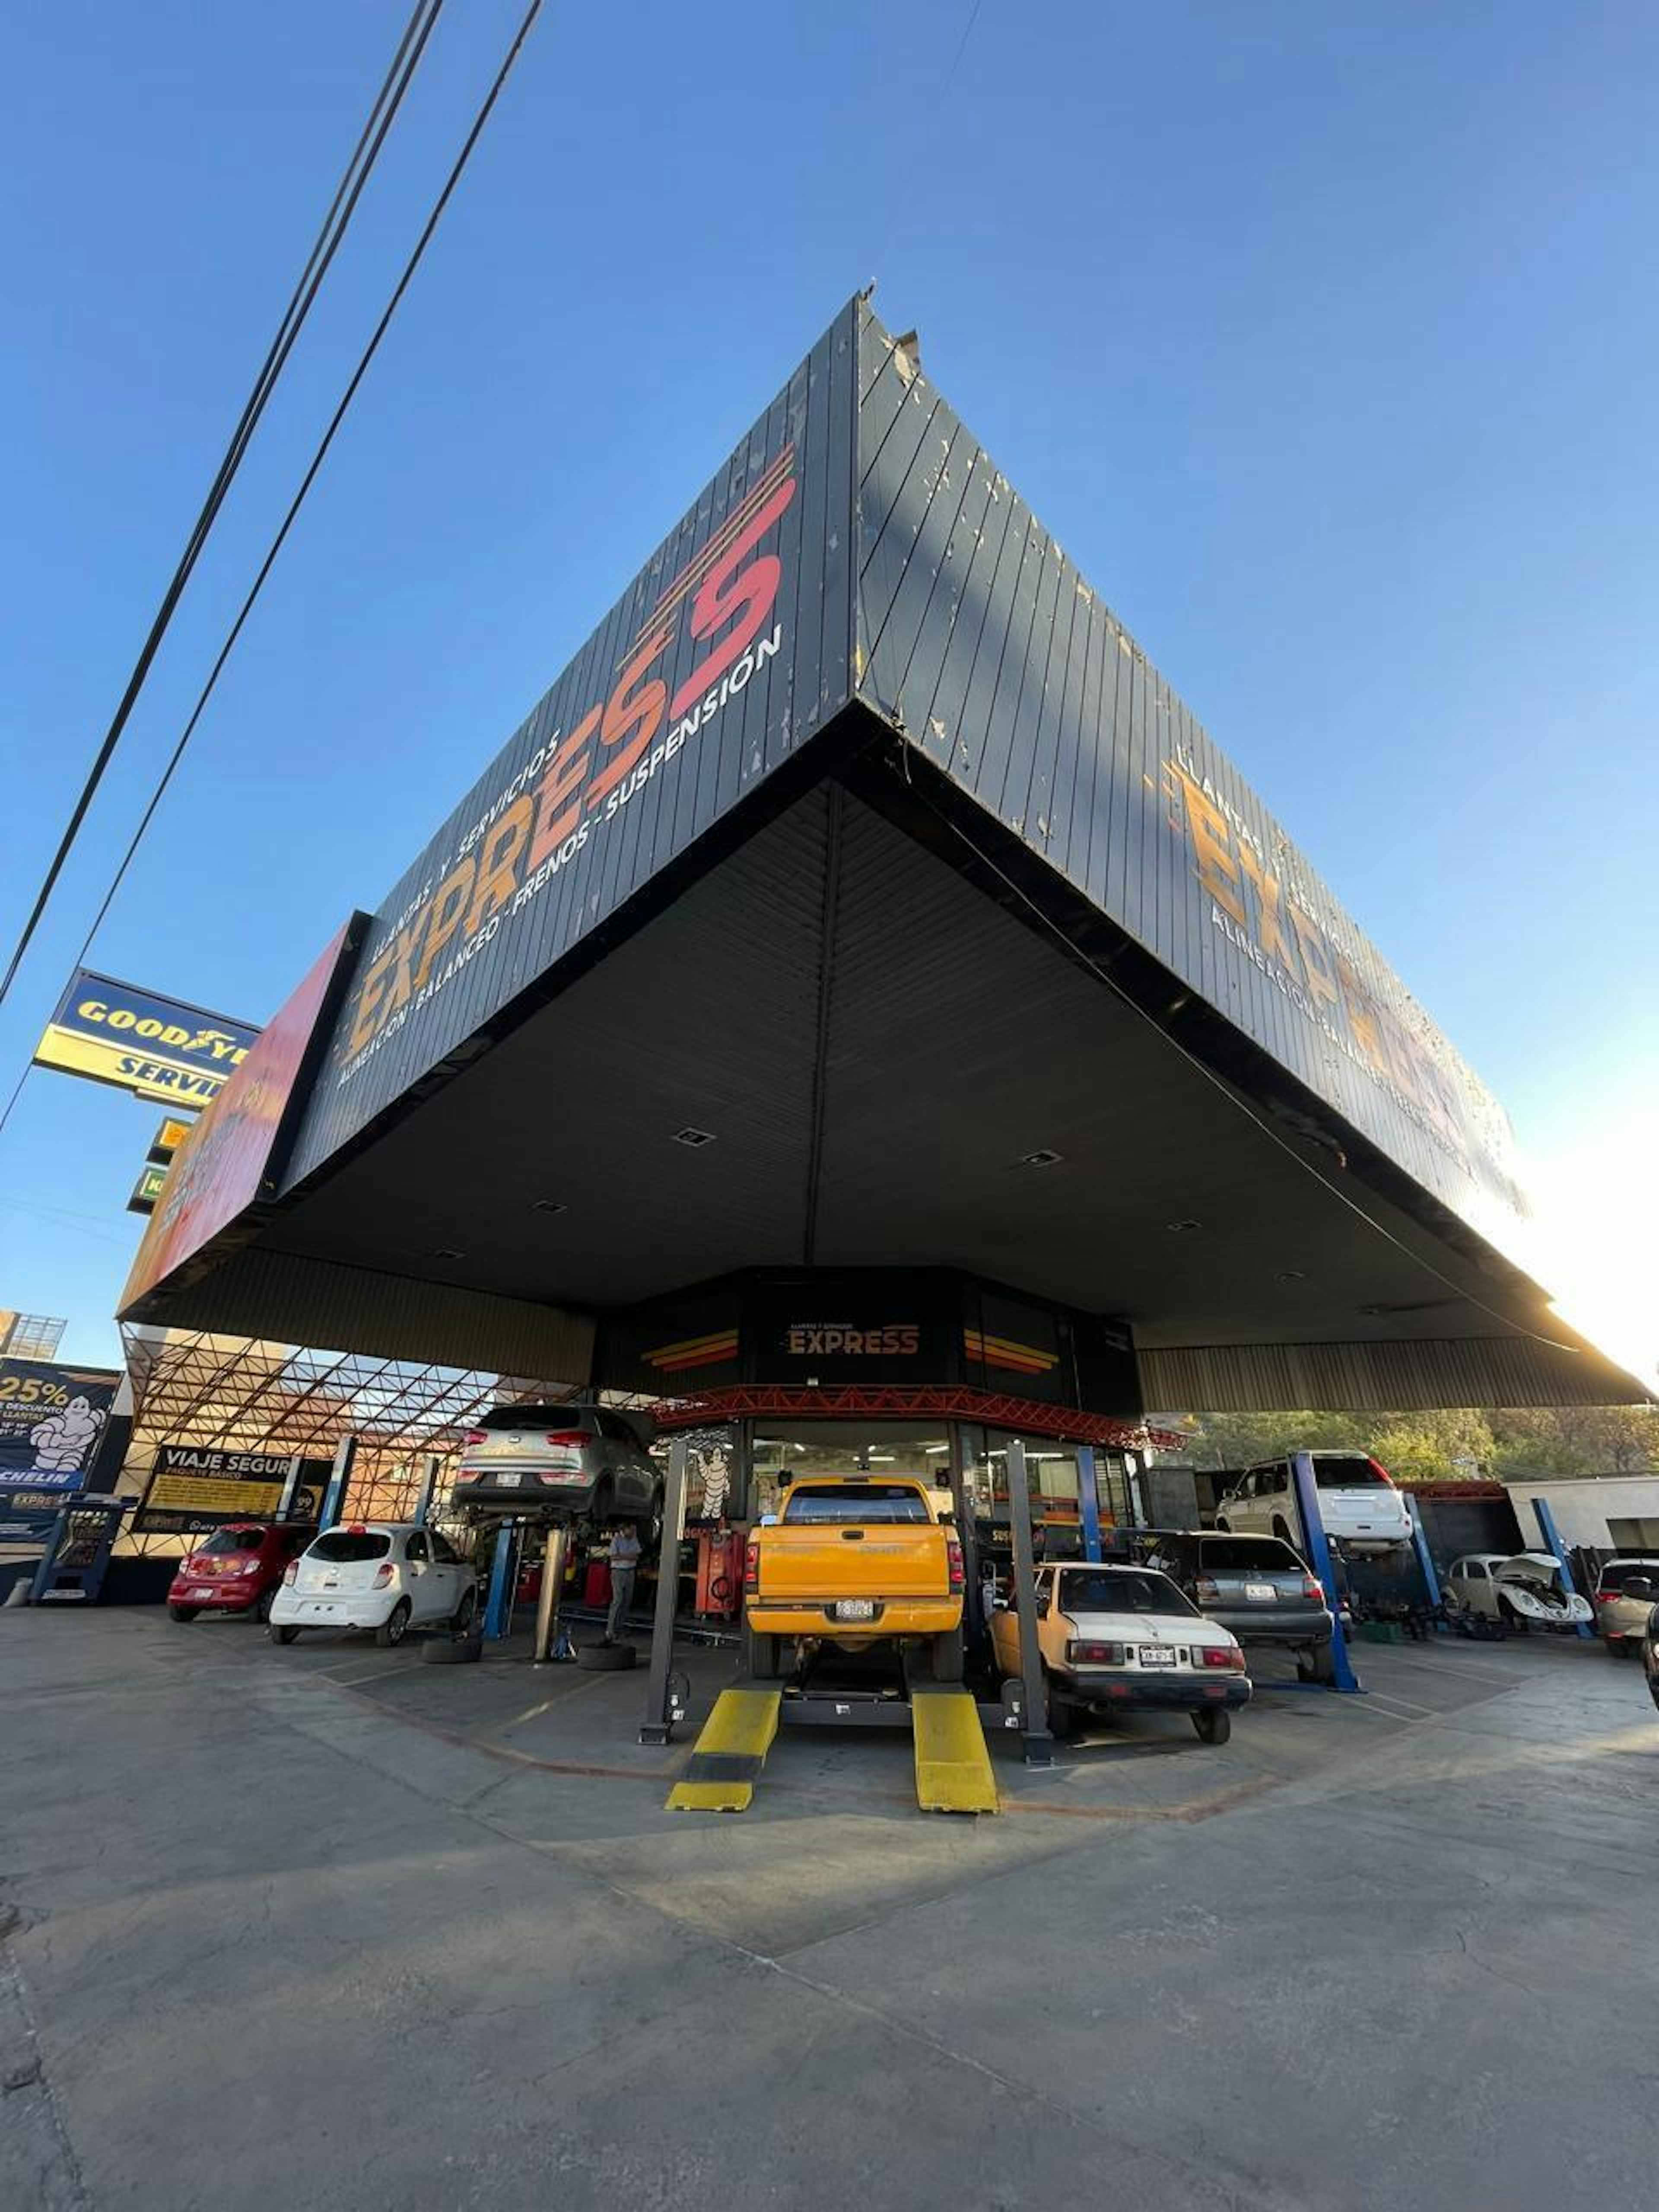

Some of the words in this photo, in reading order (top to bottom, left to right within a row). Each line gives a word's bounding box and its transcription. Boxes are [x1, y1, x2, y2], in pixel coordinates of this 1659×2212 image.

[339, 478, 796, 1065] EXPRESS
[456, 728, 561, 861] SERVICIOS
[1176, 743, 1264, 860] LLANTAS
[415, 916, 499, 1010] BALANCEO
[512, 820, 591, 915] FRENOS
[606, 624, 782, 820] SUSPENSIÓN
[787, 1329, 919, 1354] EXPRESS
[0, 1376, 69, 1405] 25%
[0, 1471, 70, 1482] CHELIN
[165, 1449, 224, 1469] VIAJE
[226, 1456, 292, 1475] SEGUR
